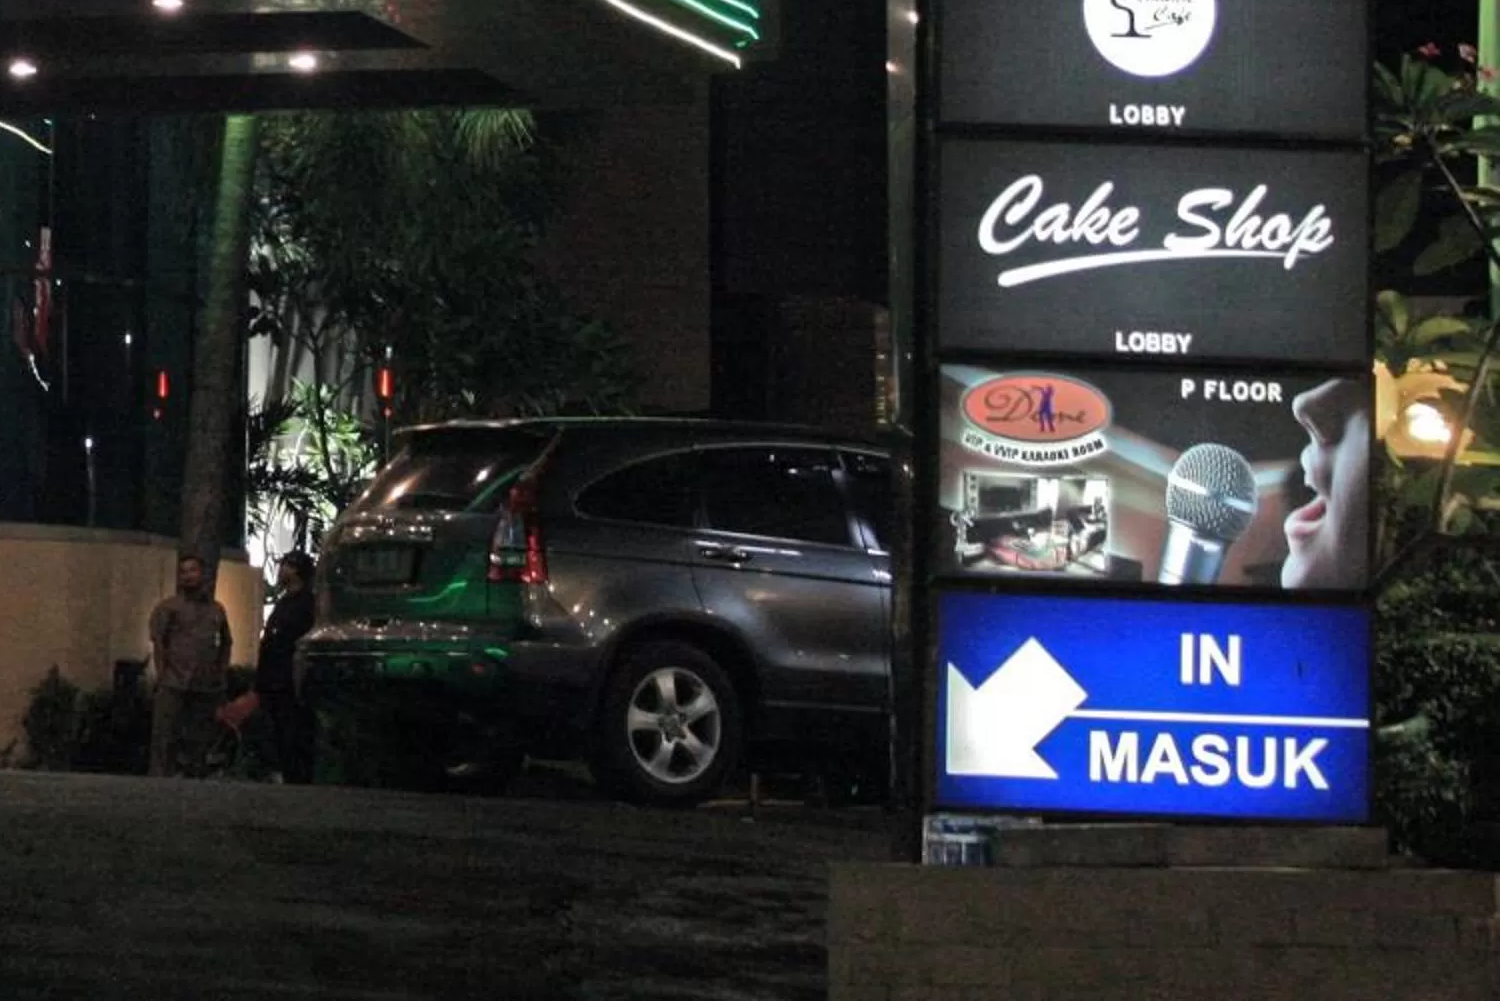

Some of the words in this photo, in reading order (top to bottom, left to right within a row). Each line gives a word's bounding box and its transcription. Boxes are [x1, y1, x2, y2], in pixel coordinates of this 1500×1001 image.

[1109, 104, 1186, 126] LOBBY
[977, 174, 1140, 255] Cake
[1163, 184, 1334, 270] Shop
[1115, 331, 1193, 354] LOBBY
[1181, 379, 1196, 399] P
[1204, 381, 1282, 402] FLOOR
[964, 433, 984, 446] VIP
[1021, 449, 1070, 462] KARAOKE
[1071, 439, 1104, 456] ROOM
[1180, 632, 1241, 686] IN
[1088, 730, 1330, 790] MASUK
